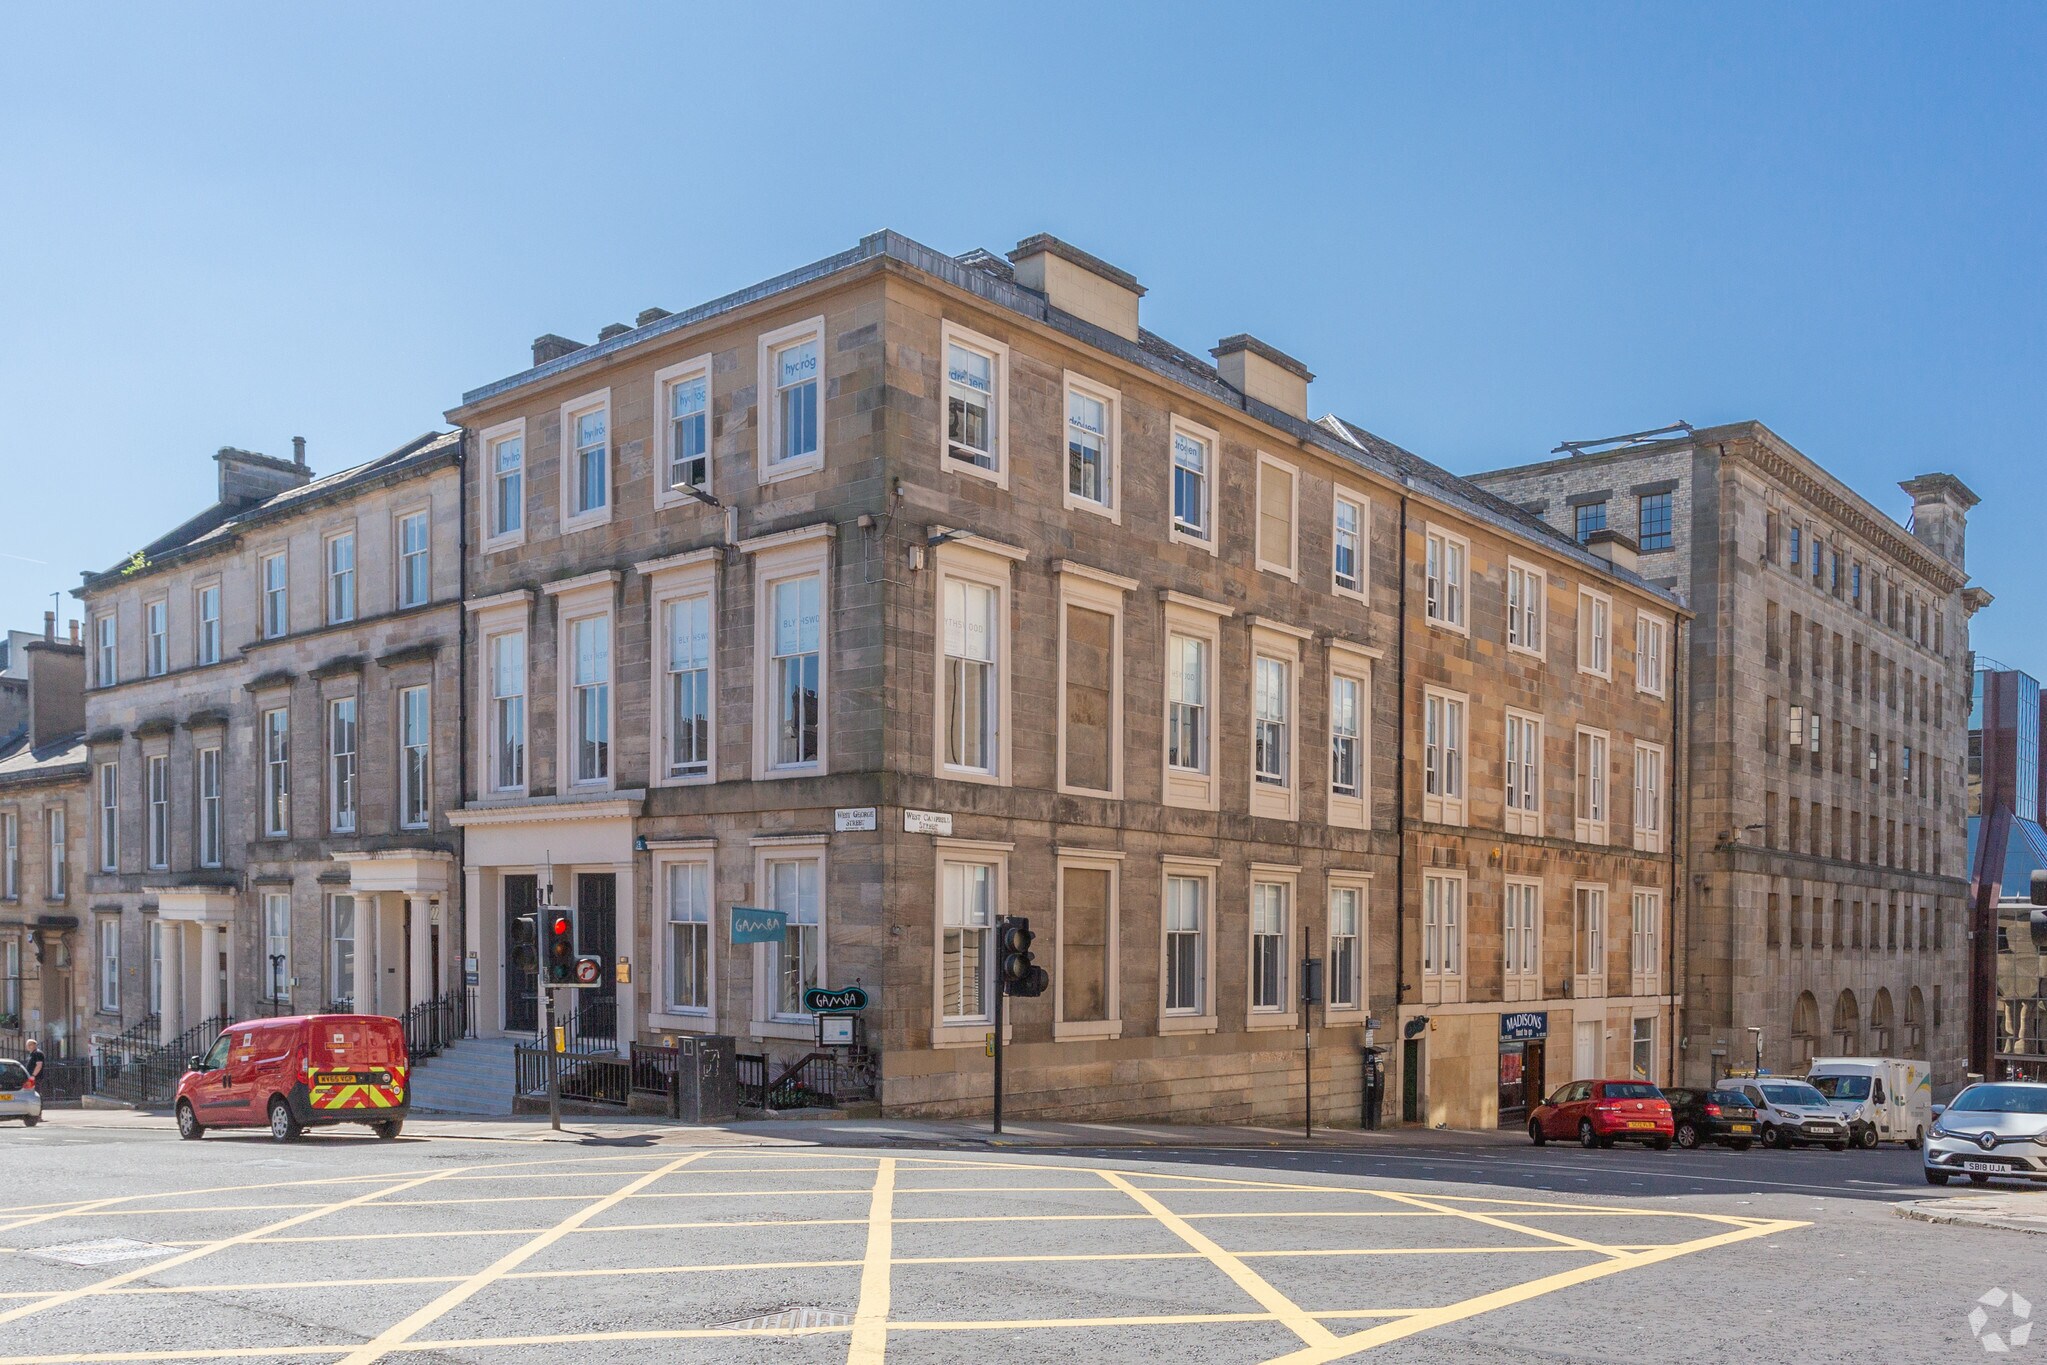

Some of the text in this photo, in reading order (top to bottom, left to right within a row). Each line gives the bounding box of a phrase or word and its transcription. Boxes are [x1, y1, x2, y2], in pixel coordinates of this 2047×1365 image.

[1506, 1013, 1543, 1032] MADISONS
[1969, 1163, 2006, 1172] SB18 UJA
